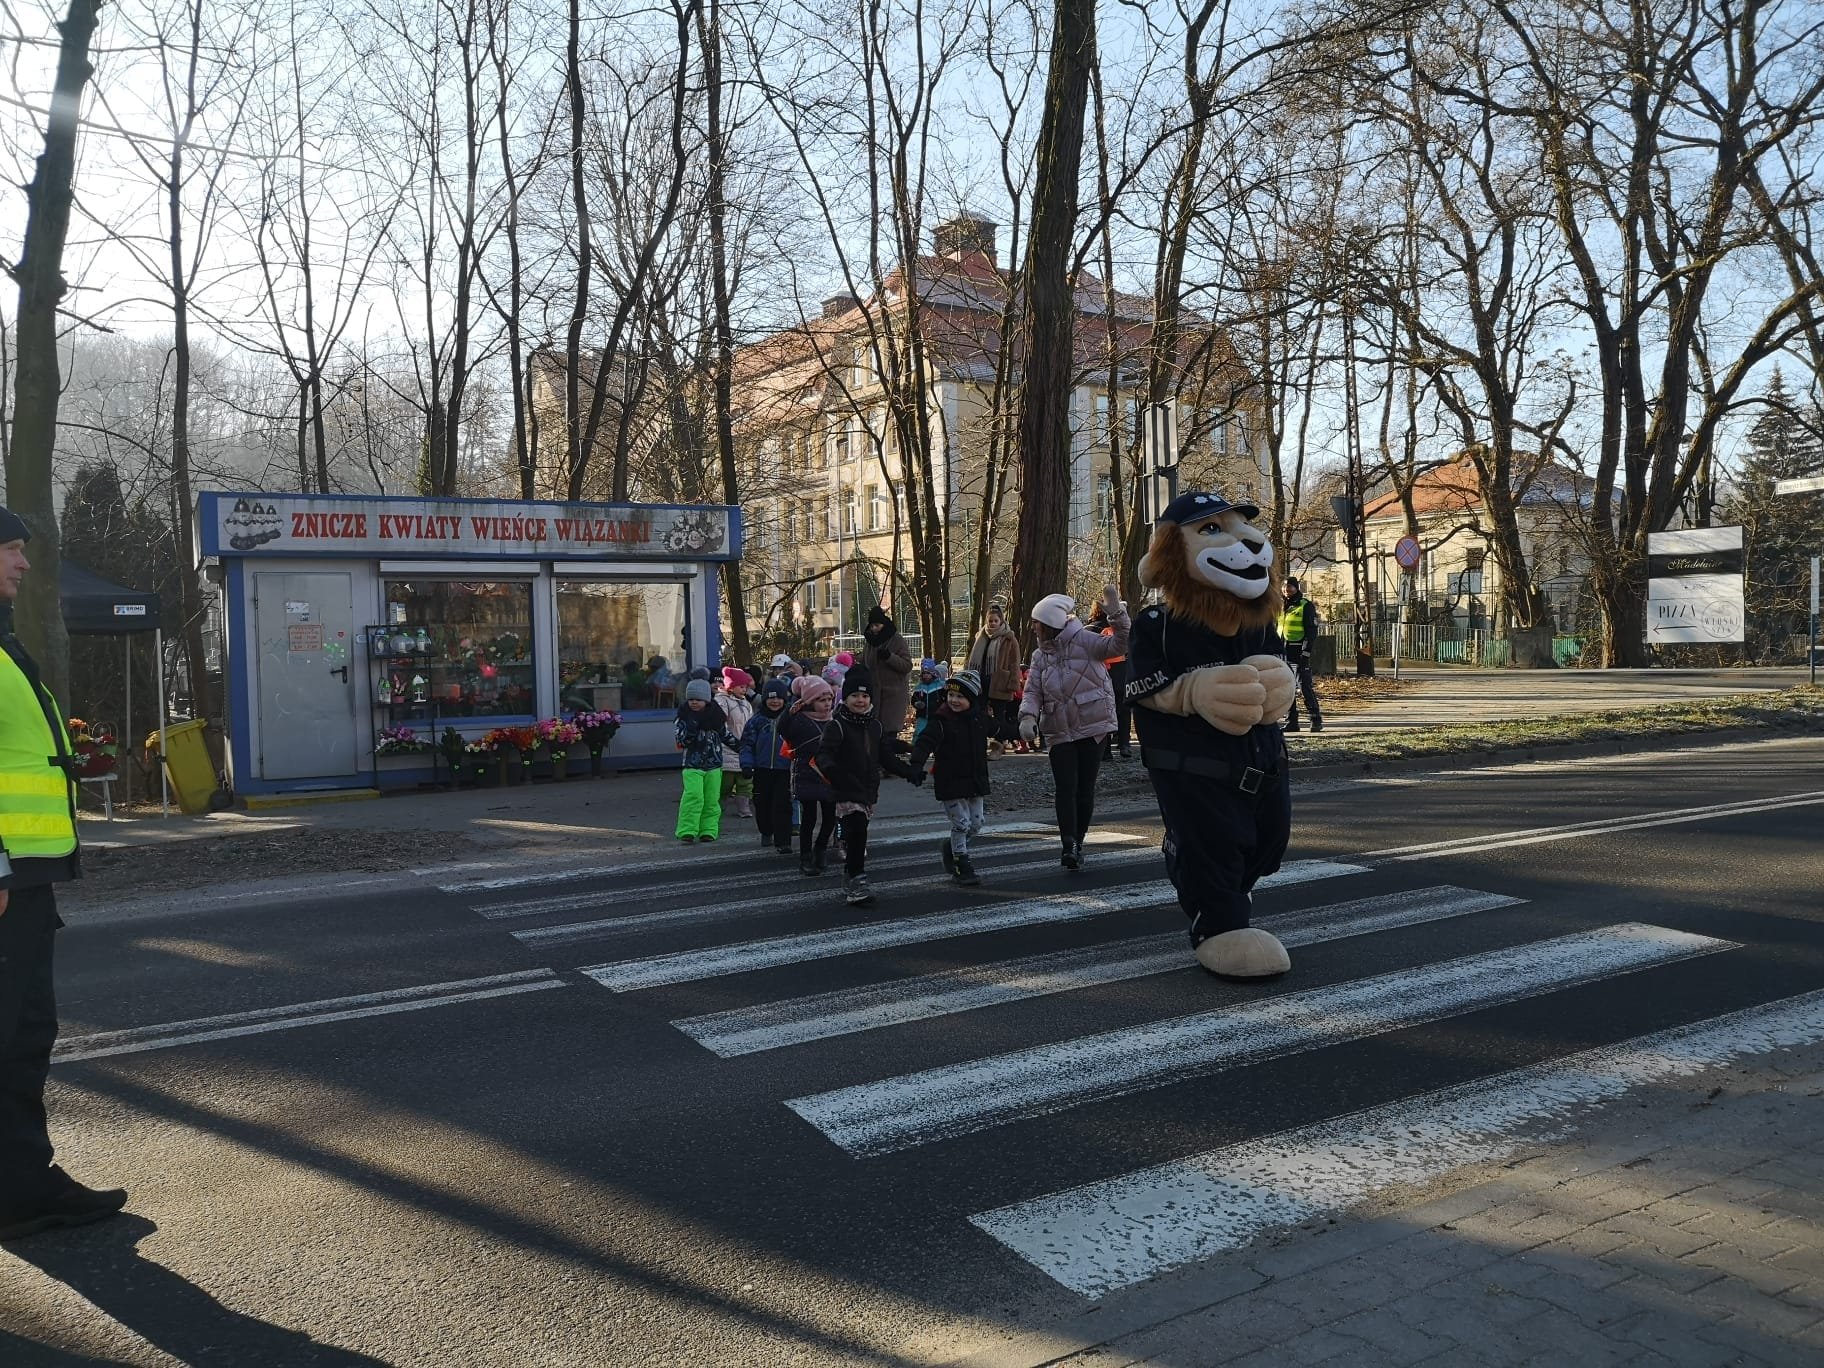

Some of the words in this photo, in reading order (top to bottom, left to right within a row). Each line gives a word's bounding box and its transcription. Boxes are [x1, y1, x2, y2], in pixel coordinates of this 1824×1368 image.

[291, 512, 367, 538] ZNICZE
[378, 514, 462, 540] KWIATY
[471, 511, 547, 542] WIEŃCE
[554, 518, 650, 547] WIĄZANKI
[1659, 604, 1696, 618] PIZZA
[1125, 670, 1169, 698] POLICJA
